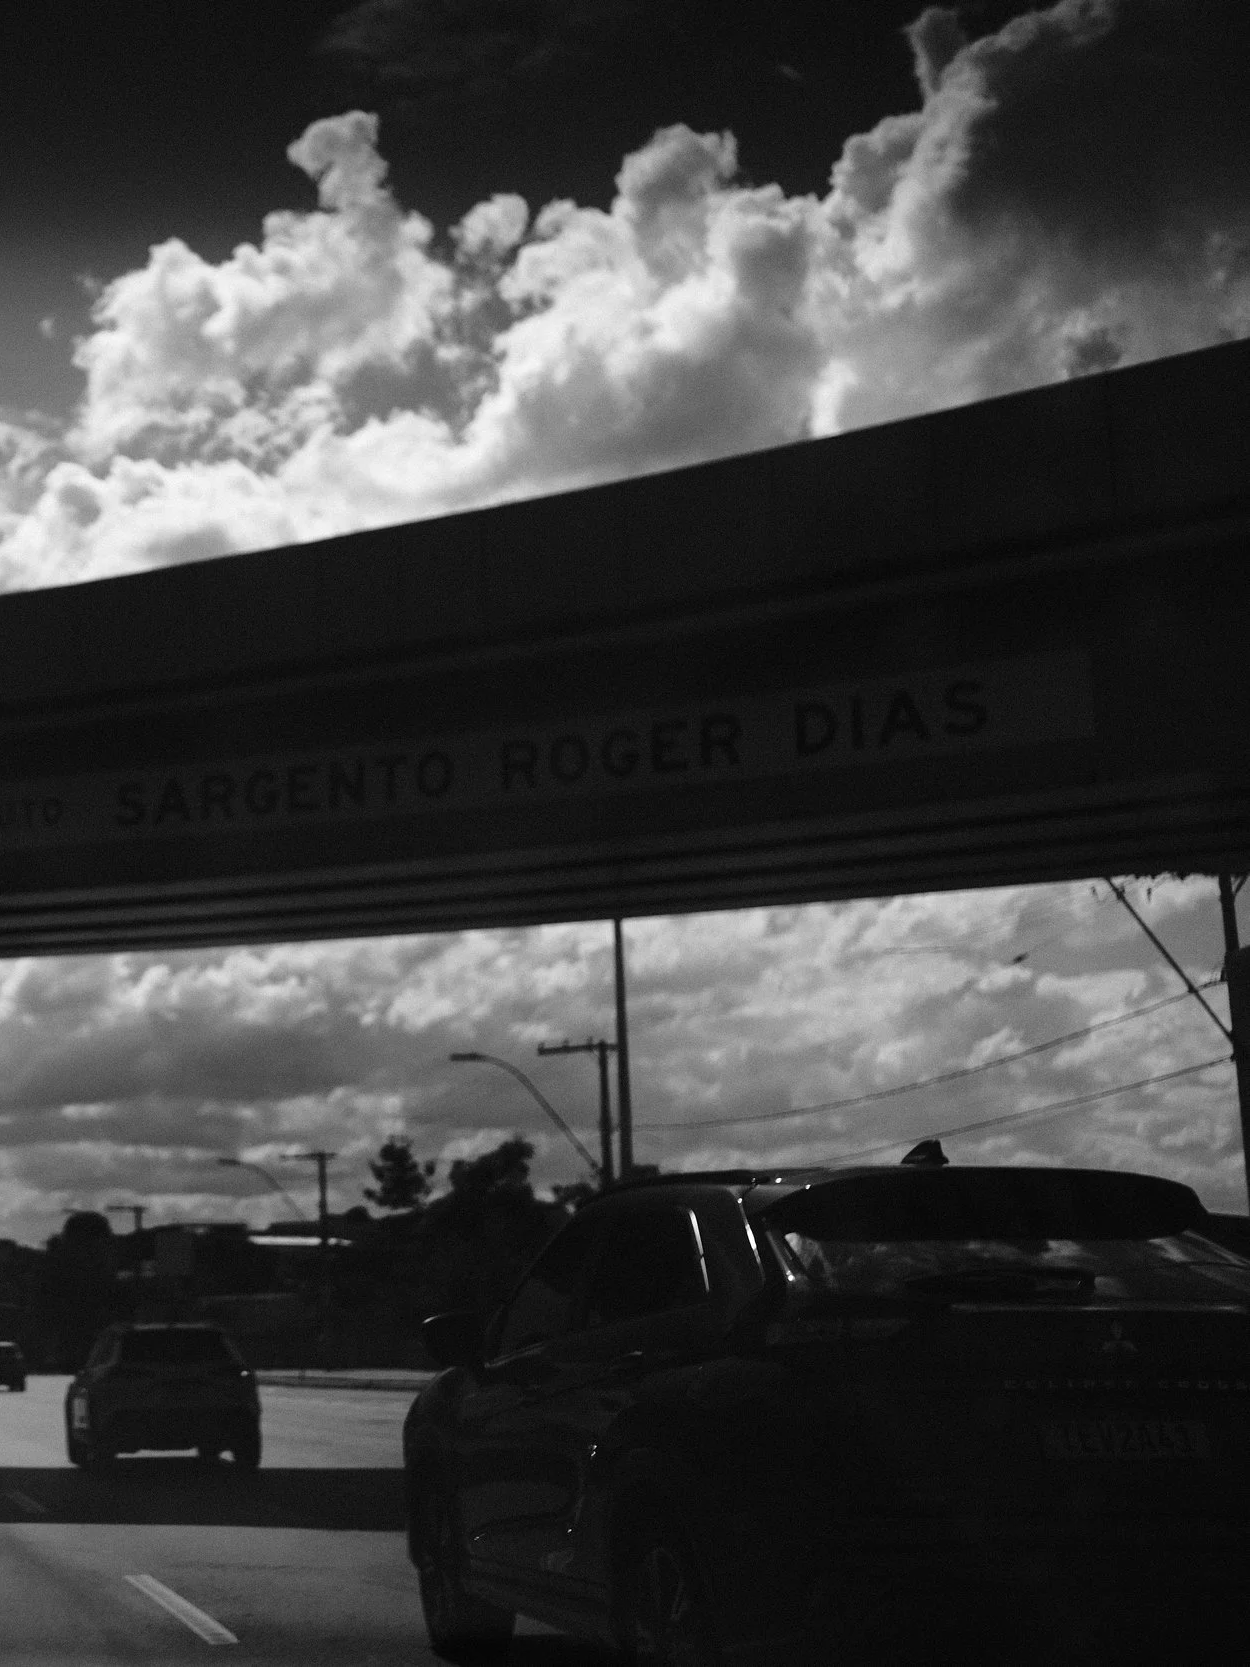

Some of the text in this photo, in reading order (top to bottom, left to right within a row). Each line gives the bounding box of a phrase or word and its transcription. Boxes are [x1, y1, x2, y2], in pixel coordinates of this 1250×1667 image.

[114, 750, 455, 826] SARGENTO
[500, 713, 743, 790] ROGER
[794, 680, 988, 757] DIAS
